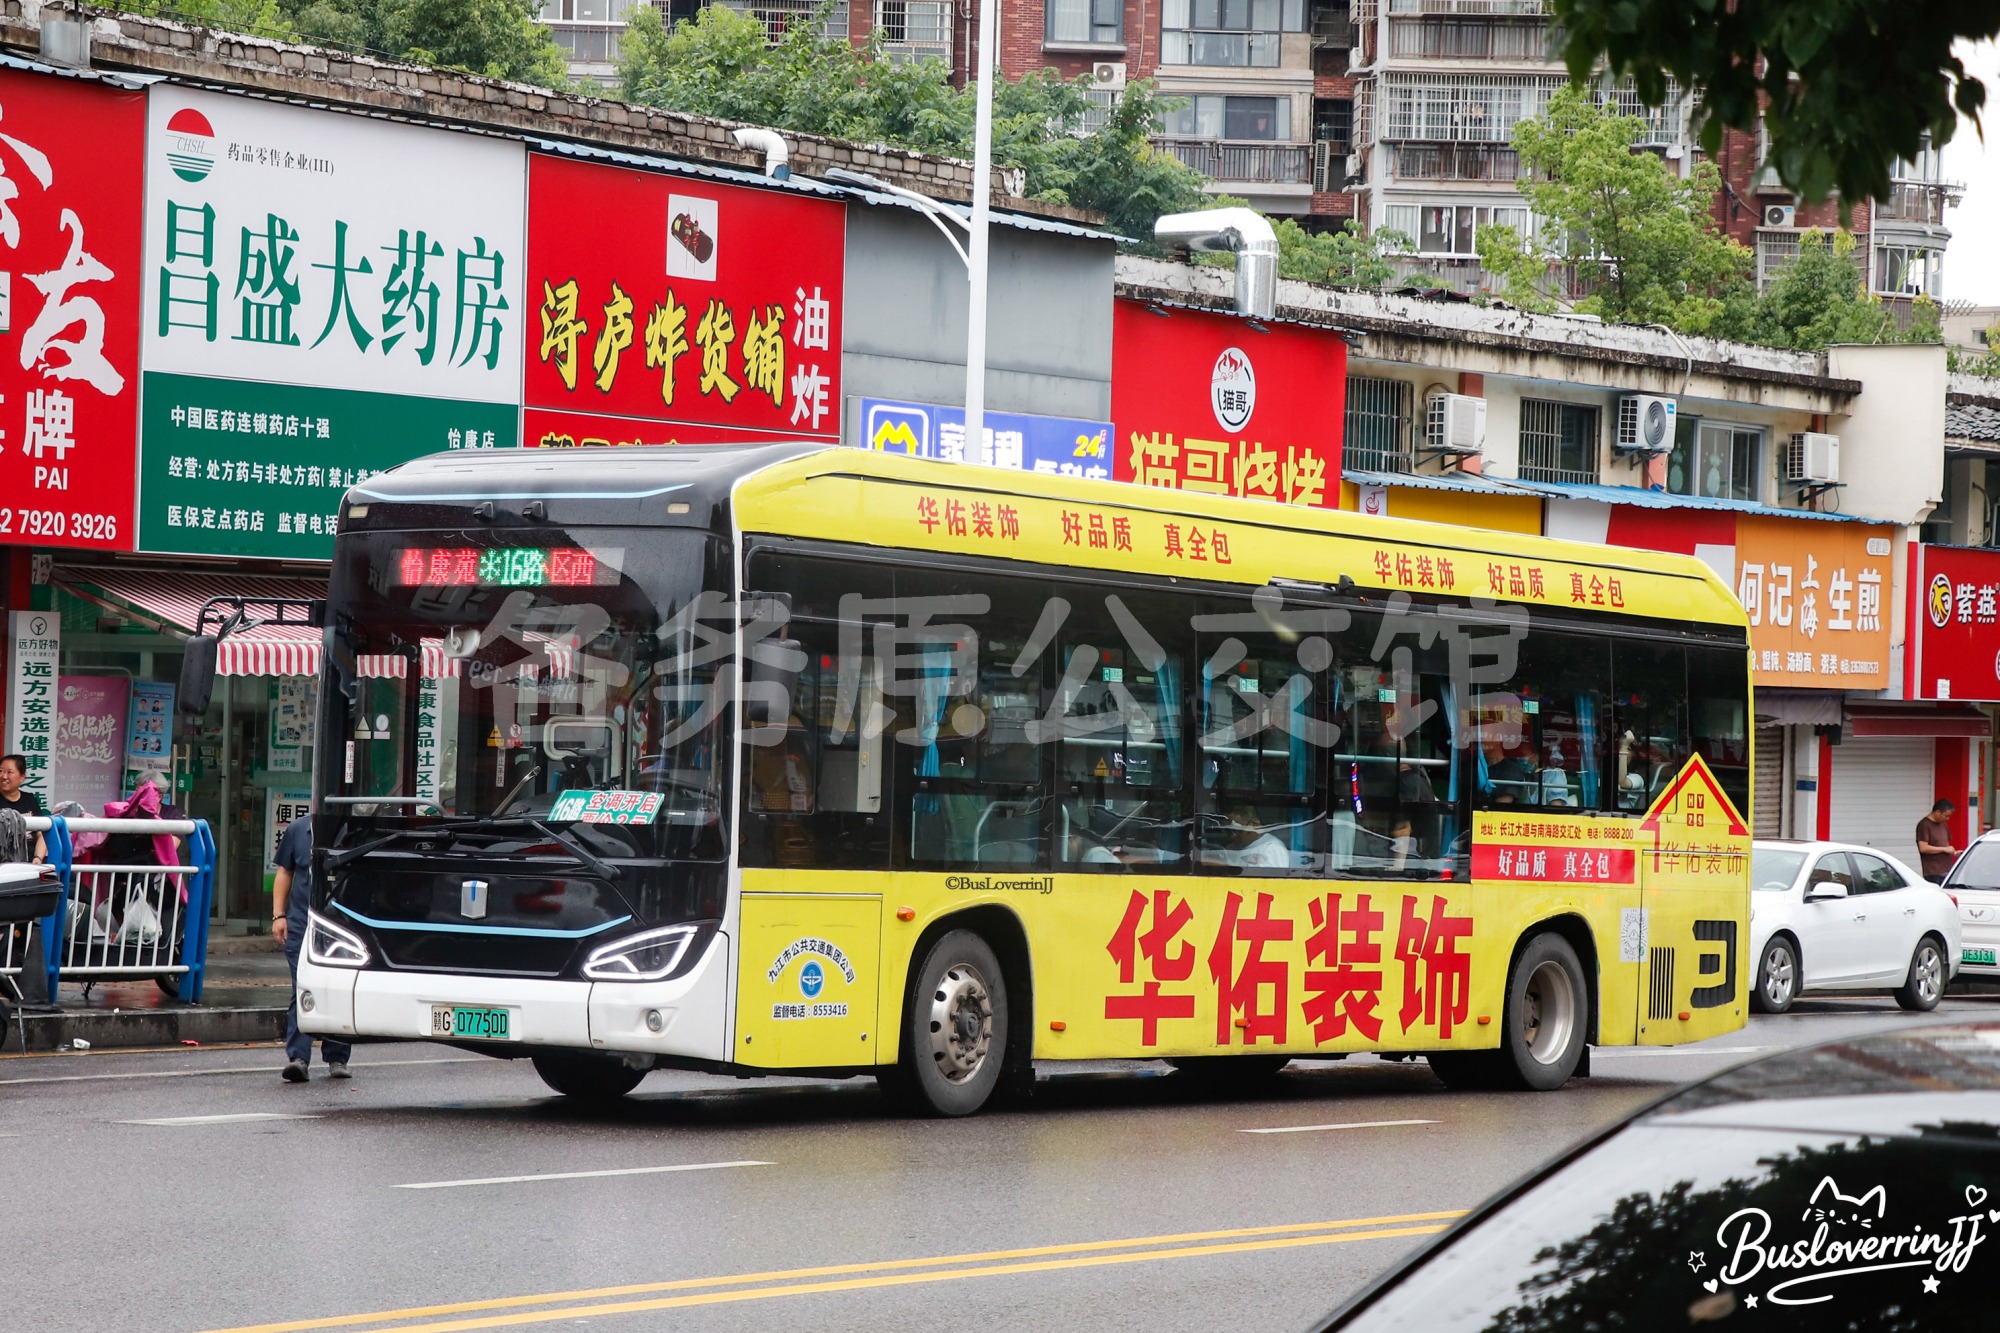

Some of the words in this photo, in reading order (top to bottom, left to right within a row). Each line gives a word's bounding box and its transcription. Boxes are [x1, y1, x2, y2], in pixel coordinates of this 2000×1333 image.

[177, 137, 205, 154] CHSH
[158, 199, 510, 371] 昌盛大药房
[539, 278, 787, 408] 浔庐炸货铺
[790, 286, 830, 429] 油炸
[1222, 389, 1247, 413] 猫哥
[0, 389, 75, 460] 牌
[170, 405, 330, 439] 中国医药连锁药店十强
[447, 428, 496, 449] 怡康店
[1073, 435, 1100, 457] 24
[34, 466, 68, 490] PAI
[1129, 431, 1326, 507] 猫哥烧烤
[18, 509, 66, 537] 7920
[70, 512, 117, 540] 3926
[167, 504, 264, 532] 医保定点药店
[277, 512, 338, 536] 监督电话
[917, 496, 1020, 541] 华佑装饰
[1061, 509, 1133, 553] 好品质
[1164, 522, 1232, 565] 真全包
[1374, 549, 1455, 590] 华佑装饰
[1488, 561, 1545, 599] 好品质
[1569, 571, 1624, 609] 真全包
[586, 793, 660, 813] 空调开启
[1498, 848, 1547, 878] 好品质
[1563, 851, 1610, 879] 真全包
[1663, 841, 1743, 876] 华佑装饰
[768, 938, 855, 983] 九江市公共交通集团公司
[1105, 888, 1473, 1048] 华佑装饰
